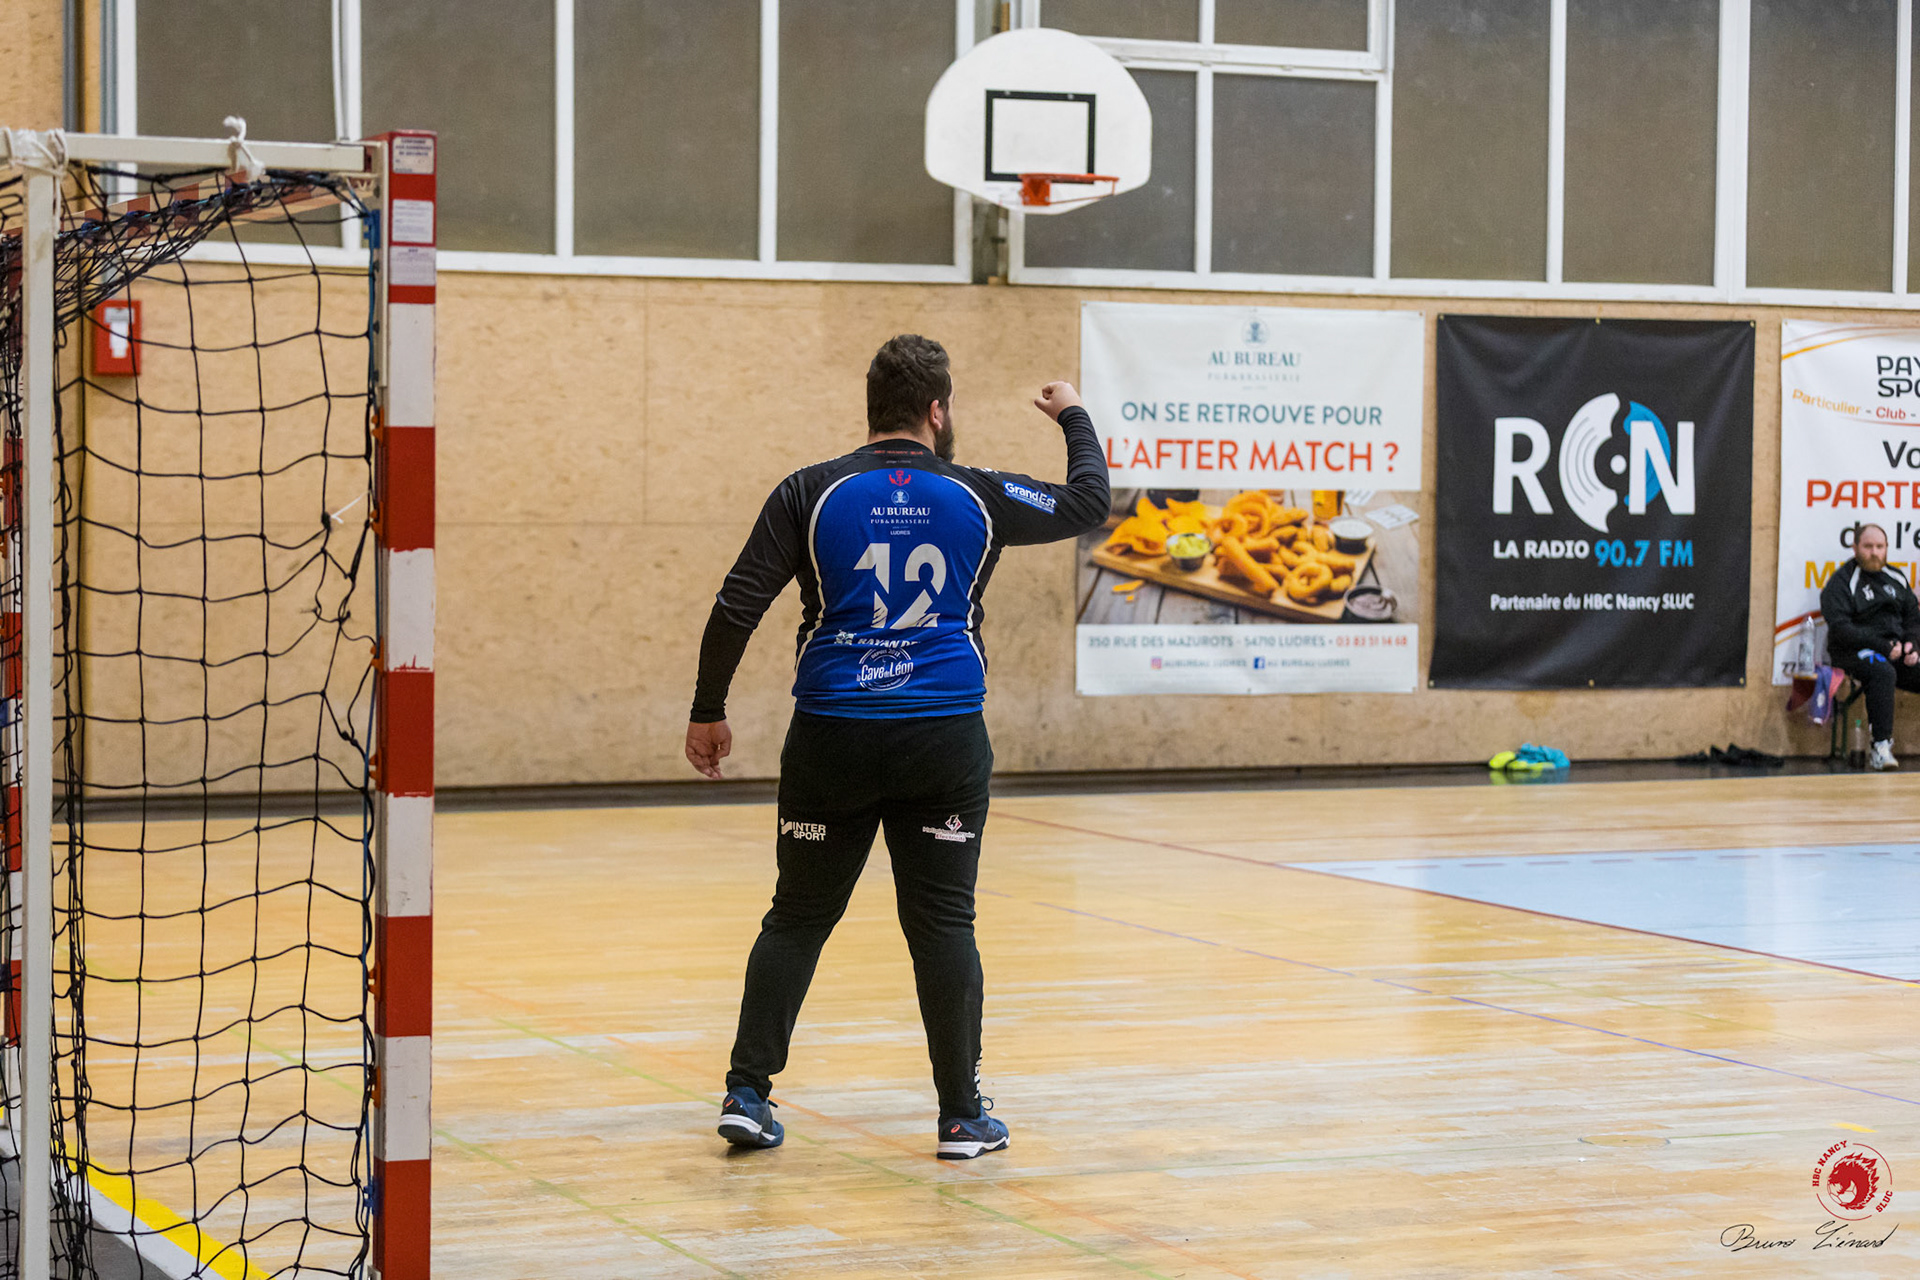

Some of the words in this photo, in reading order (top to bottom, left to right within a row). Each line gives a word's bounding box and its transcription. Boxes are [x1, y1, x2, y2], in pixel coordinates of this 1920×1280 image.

[1208, 350, 1231, 366] AU
[1234, 351, 1302, 367] BUREAU
[1121, 402, 1157, 422] ON
[1165, 403, 1190, 423] SE
[1197, 403, 1315, 425] RETROUVE
[1323, 406, 1383, 426] POUR
[1792, 388, 1861, 415] Particulier
[1876, 406, 1906, 420] Club
[1107, 438, 1239, 471] L'AFTER
[1249, 441, 1373, 473] MATCH
[1384, 442, 1400, 473] ?
[870, 507, 885, 516] AU
[887, 507, 931, 516] BUREAU
[1493, 540, 1520, 559] LA
[1524, 540, 1591, 559] RADIO
[1594, 540, 1650, 567] 90.7
[1659, 540, 1694, 567] FM
[853, 543, 947, 629] 12
[1490, 593, 1561, 611] Partenaire
[1563, 592, 1581, 610] du
[1583, 593, 1613, 611] HBC
[1616, 593, 1660, 613] Nancy
[1662, 593, 1695, 610] SLUC
[1113, 636, 1137, 647] RUE
[1141, 636, 1164, 647] DES
[1278, 635, 1326, 647] LUDRES
[861, 664, 885, 682] Cave
[889, 661, 914, 678] Léon
[792, 821, 826, 834] INTER
[793, 830, 826, 841] SPORT
